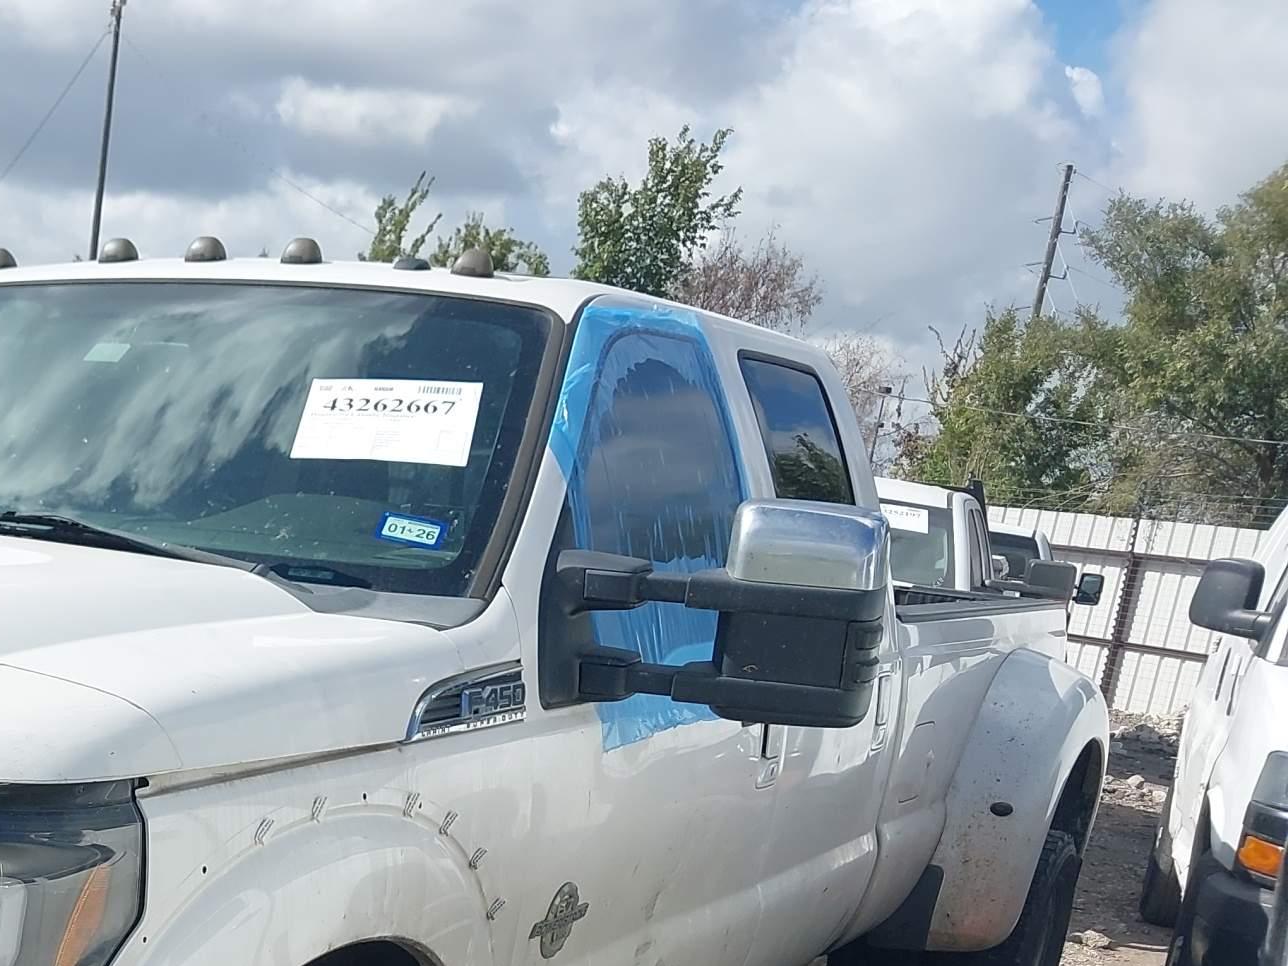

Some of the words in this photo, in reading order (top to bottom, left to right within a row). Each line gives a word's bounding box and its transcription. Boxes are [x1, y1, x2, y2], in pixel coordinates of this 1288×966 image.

[322, 396, 457, 416] 43262667
[387, 522, 407, 535] 01
[414, 528, 436, 541] 26
